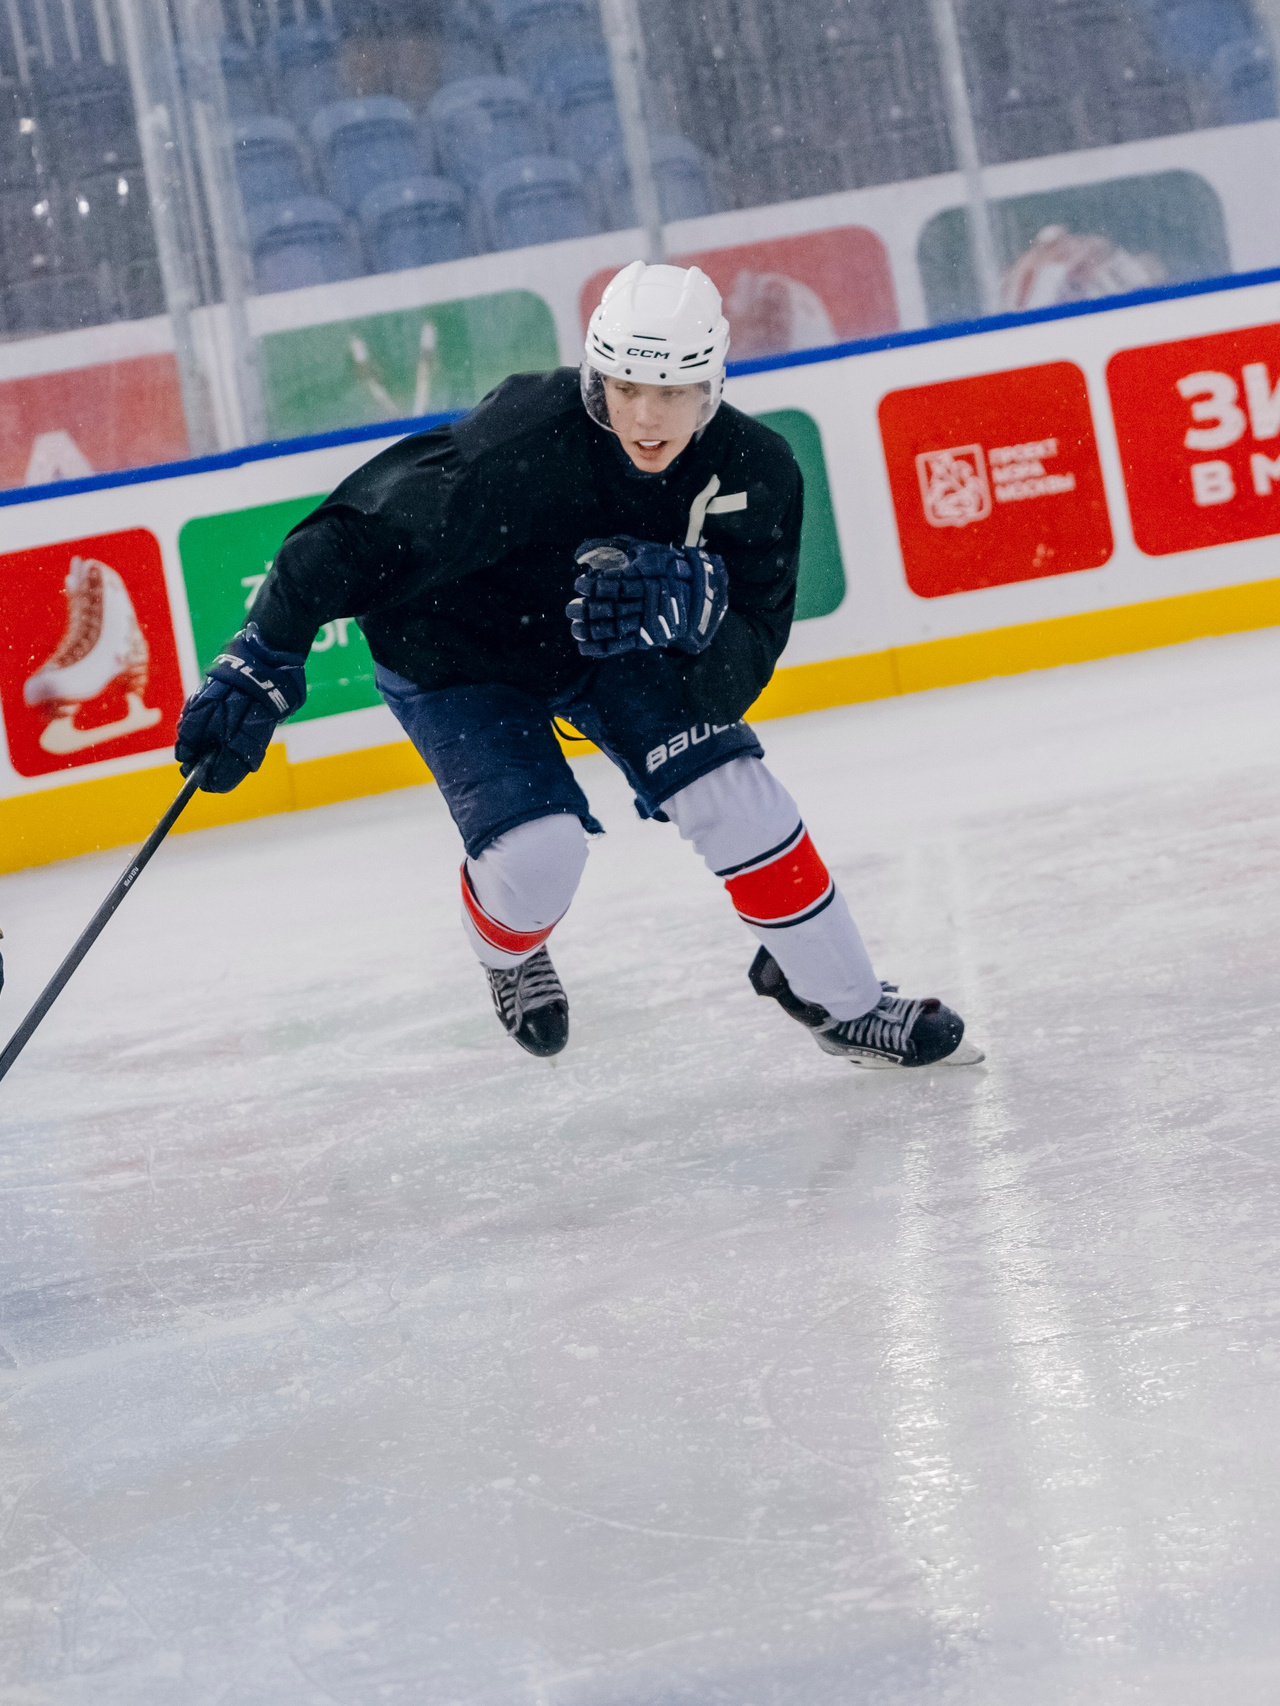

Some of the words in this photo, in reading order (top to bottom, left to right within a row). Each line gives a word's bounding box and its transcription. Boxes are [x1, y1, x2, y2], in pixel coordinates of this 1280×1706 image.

[626, 347, 670, 360] CCM
[1190, 459, 1236, 507] В
[646, 718, 745, 774] BAU
